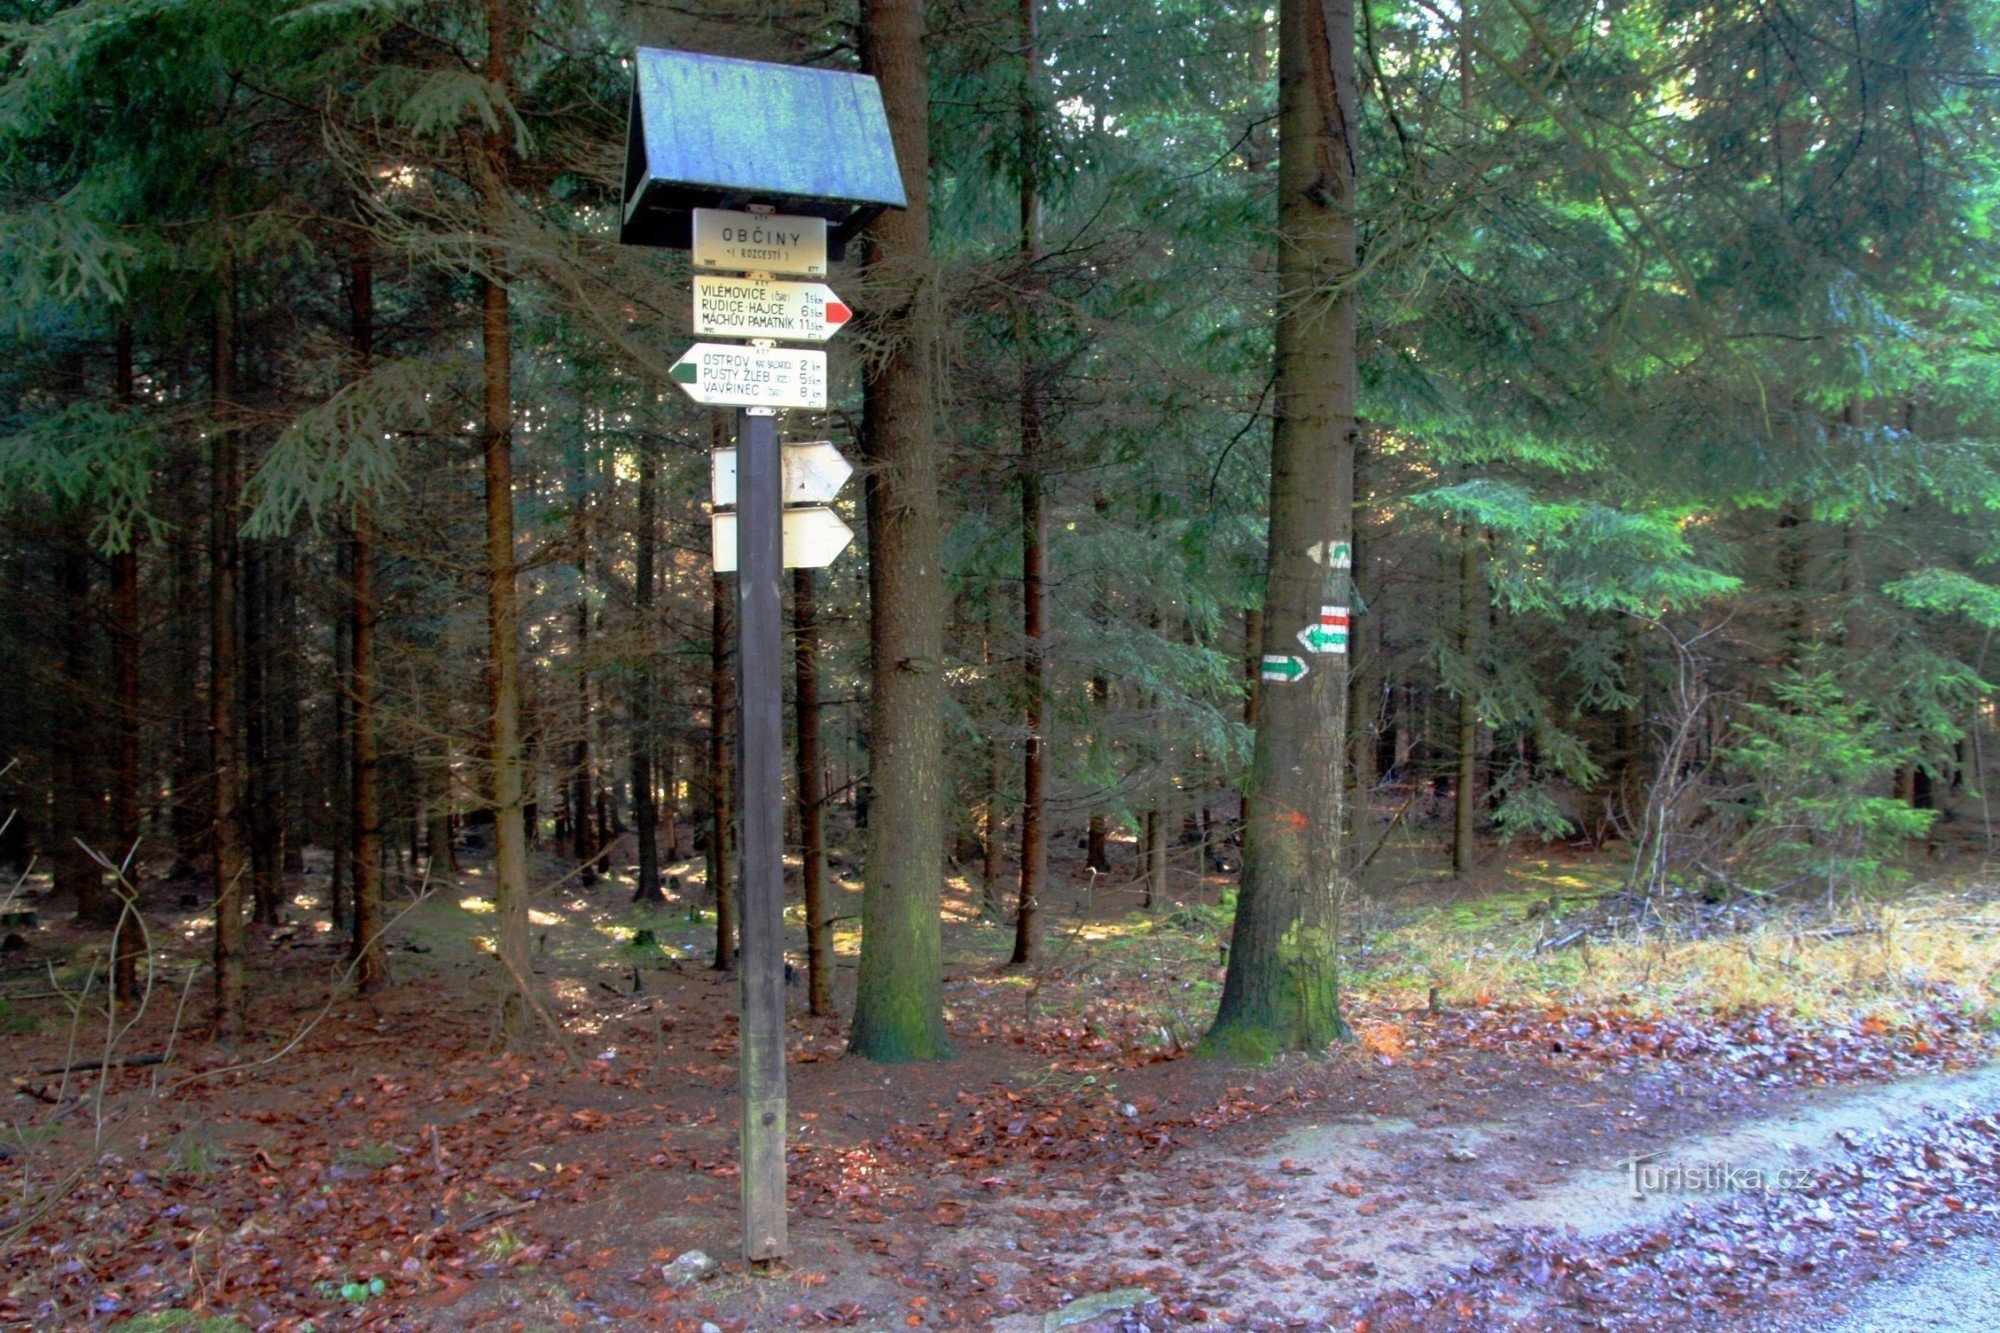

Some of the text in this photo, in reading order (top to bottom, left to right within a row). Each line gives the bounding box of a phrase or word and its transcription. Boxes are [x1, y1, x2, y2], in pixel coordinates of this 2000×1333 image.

[722, 226, 801, 247] OBČINY
[701, 283, 766, 301] VILÉMOVICE
[703, 353, 750, 367] OSTROV
[800, 359, 808, 371] 2
[743, 367, 770, 382] ŽLEB
[703, 380, 760, 396] VAVŘINEC
[799, 386, 808, 398] 8
